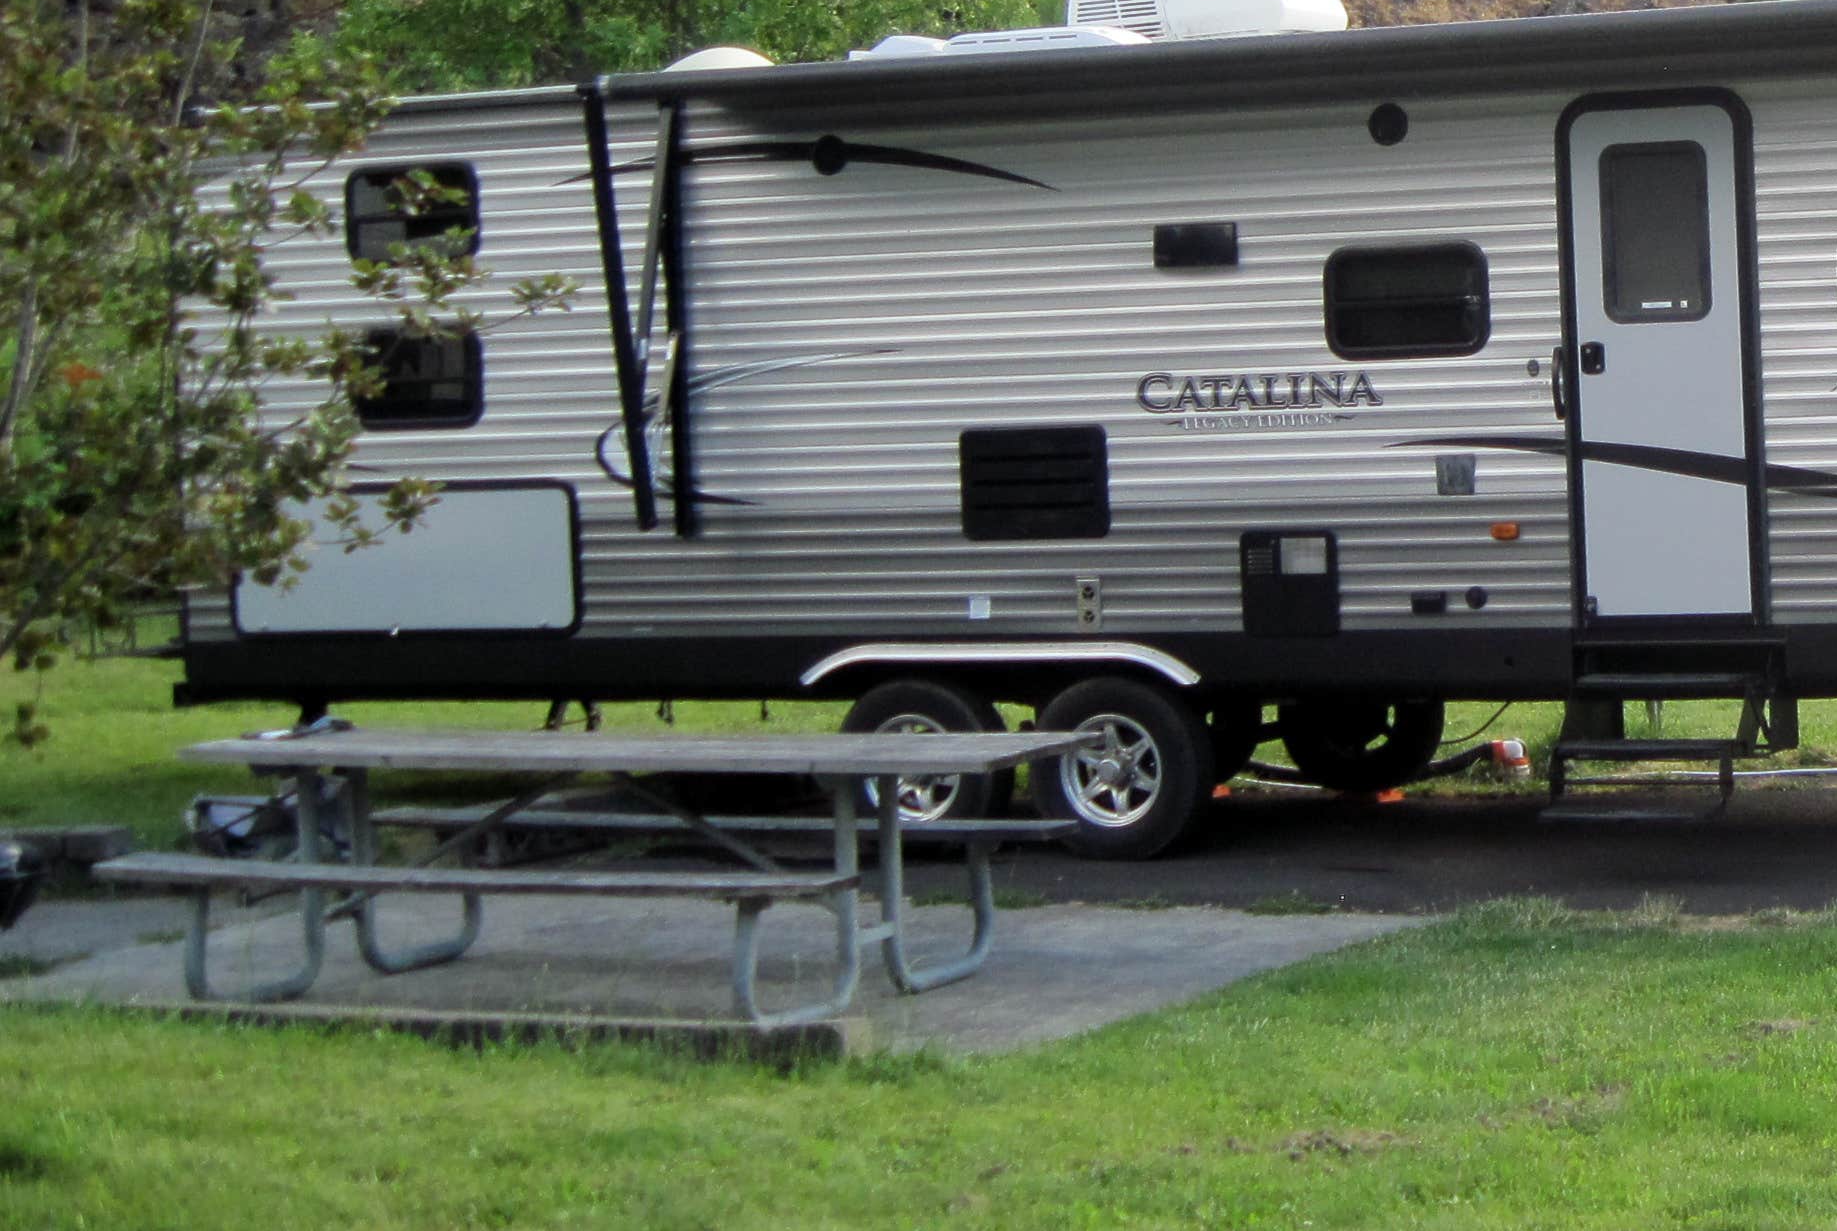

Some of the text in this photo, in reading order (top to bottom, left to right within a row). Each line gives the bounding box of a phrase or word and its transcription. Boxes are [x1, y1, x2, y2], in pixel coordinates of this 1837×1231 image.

[1136, 370, 1383, 413] CATALINA
[1183, 413, 1334, 430] LEGACY EDITION
